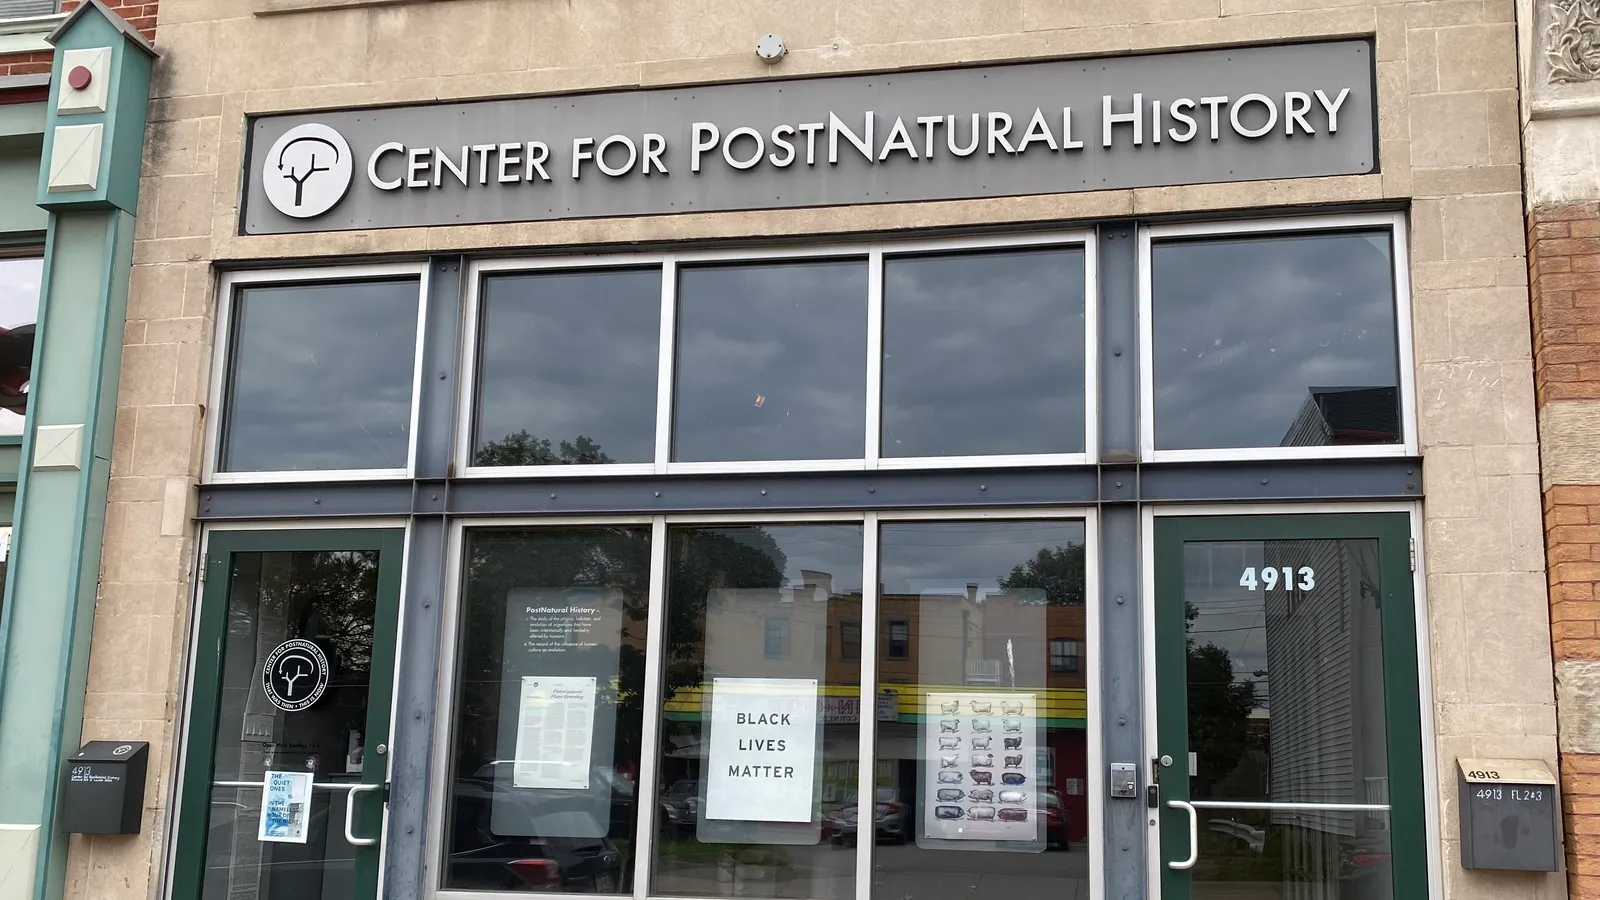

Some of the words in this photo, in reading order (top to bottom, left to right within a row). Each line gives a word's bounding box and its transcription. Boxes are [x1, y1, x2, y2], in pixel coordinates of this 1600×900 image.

[367, 141, 551, 190] CENTER
[571, 133, 669, 179] FOR
[1102, 88, 1351, 148] HISTORY
[1239, 566, 1315, 591] 4913
[526, 606, 568, 614] PostNatural
[570, 607, 595, 615] History
[265, 655, 276, 675] CENTER
[275, 646, 285, 656] FOR
[285, 641, 319, 655] POSTNATURAL
[317, 653, 327, 676] HISTORY
[265, 682, 273, 695] THAT
[271, 694, 281, 705] WAS
[299, 699, 310, 708] THIS
[314, 682, 324, 697] NOW
[736, 712, 791, 726] BLACK
[738, 739, 787, 752] LIVES
[71, 766, 92, 776] 4913
[728, 765, 794, 778] MATTER
[1468, 770, 1500, 780] 4913
[1476, 789, 1502, 800] 4913
[1511, 789, 1522, 800] FL
